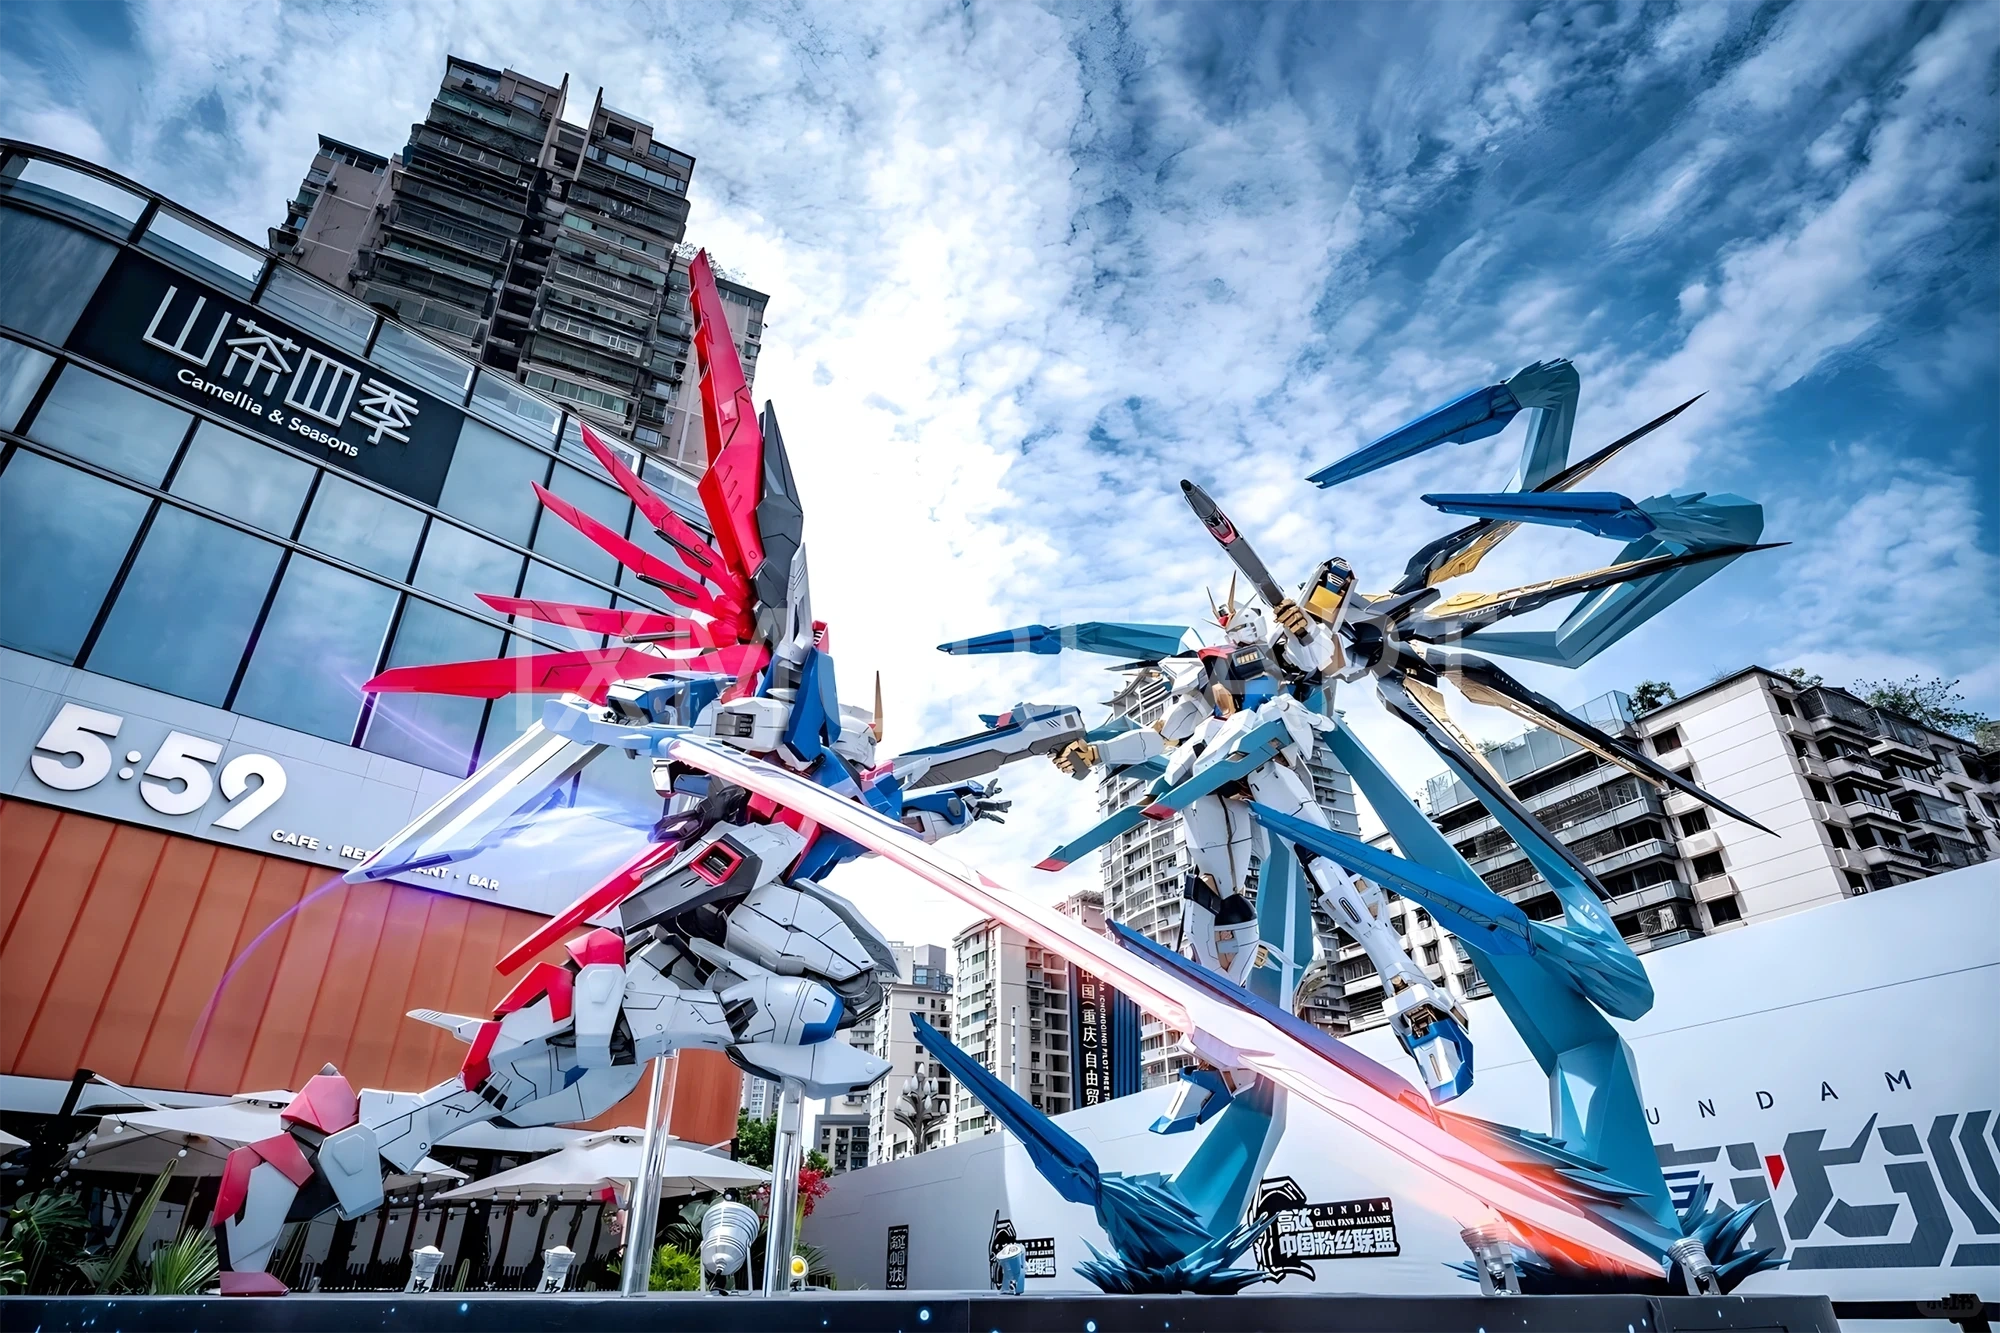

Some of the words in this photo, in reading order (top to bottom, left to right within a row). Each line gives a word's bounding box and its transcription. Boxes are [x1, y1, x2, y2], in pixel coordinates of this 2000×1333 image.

[142, 285, 419, 445] 山茶四季
[177, 369, 262, 416] Camellia
[268, 409, 284, 425] &
[288, 415, 359, 457] Seasons
[30, 702, 287, 831] 5:59
[271, 829, 320, 850] CAFE
[468, 874, 500, 891] BAR
[1645, 1069, 1912, 1125] UNDAM
[1277, 1208, 1314, 1235] 高达
[1314, 1202, 1389, 1216] GUNDAM
[1356, 1215, 1391, 1226] ALLIANCE
[1279, 1227, 1397, 1258] 中国粉丝联盟
